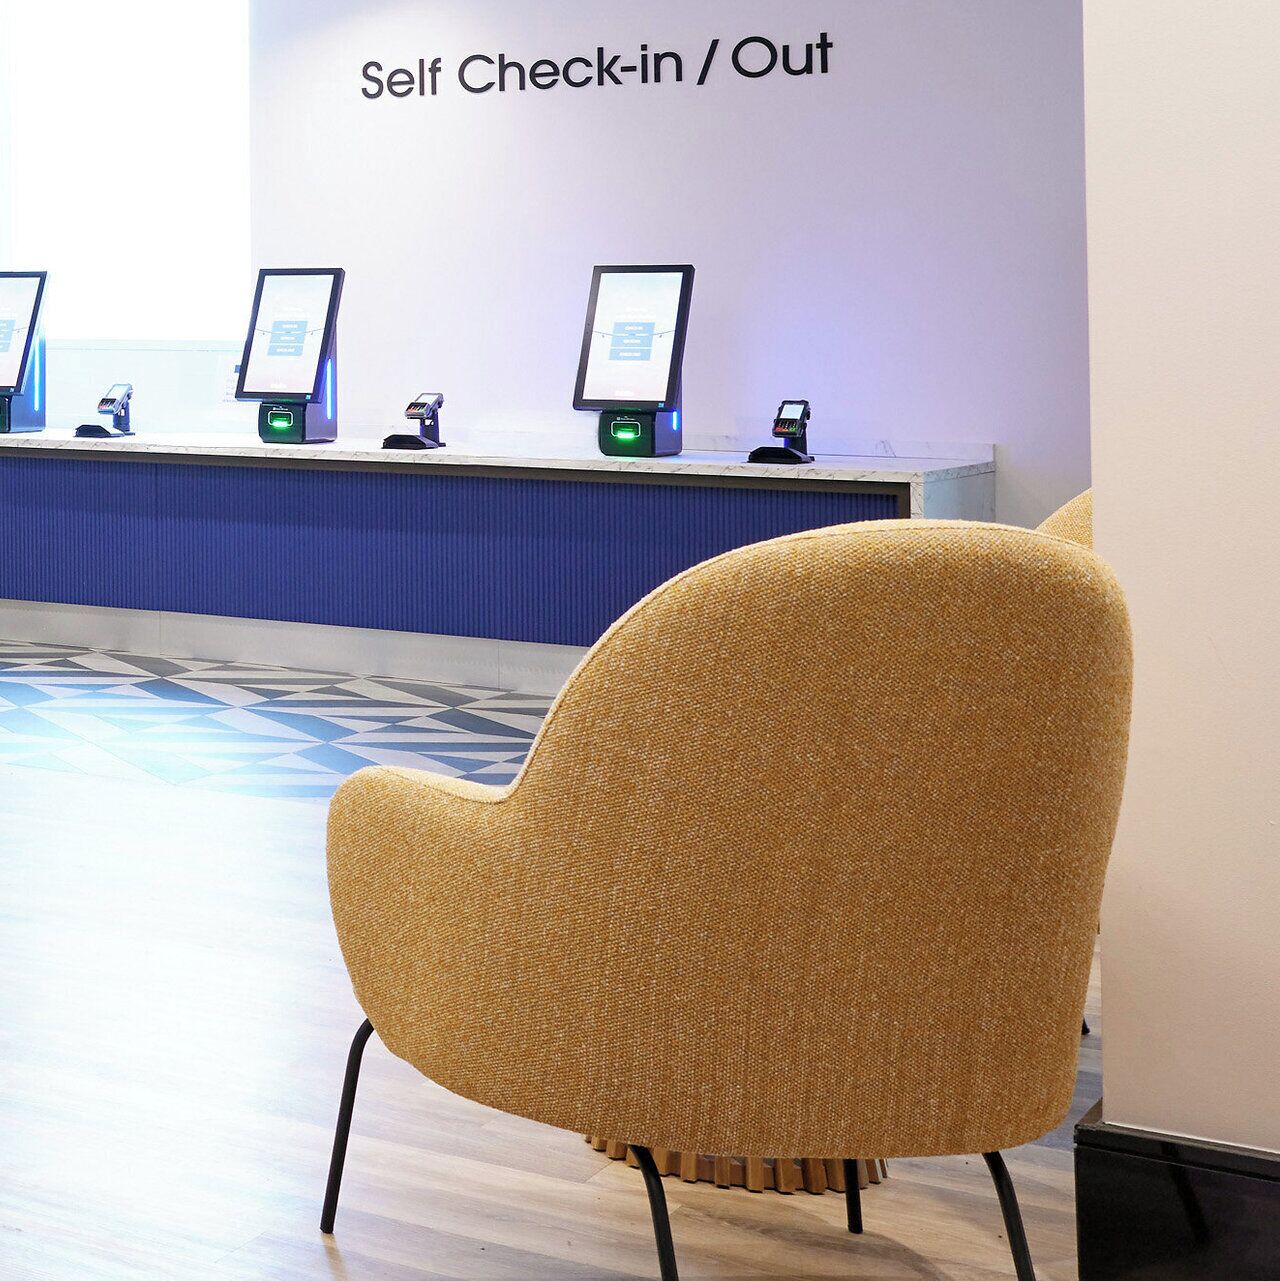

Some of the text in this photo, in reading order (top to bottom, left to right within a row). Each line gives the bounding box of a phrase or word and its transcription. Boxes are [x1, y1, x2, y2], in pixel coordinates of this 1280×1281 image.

[361, 32, 834, 99] Self Check-in / Out
